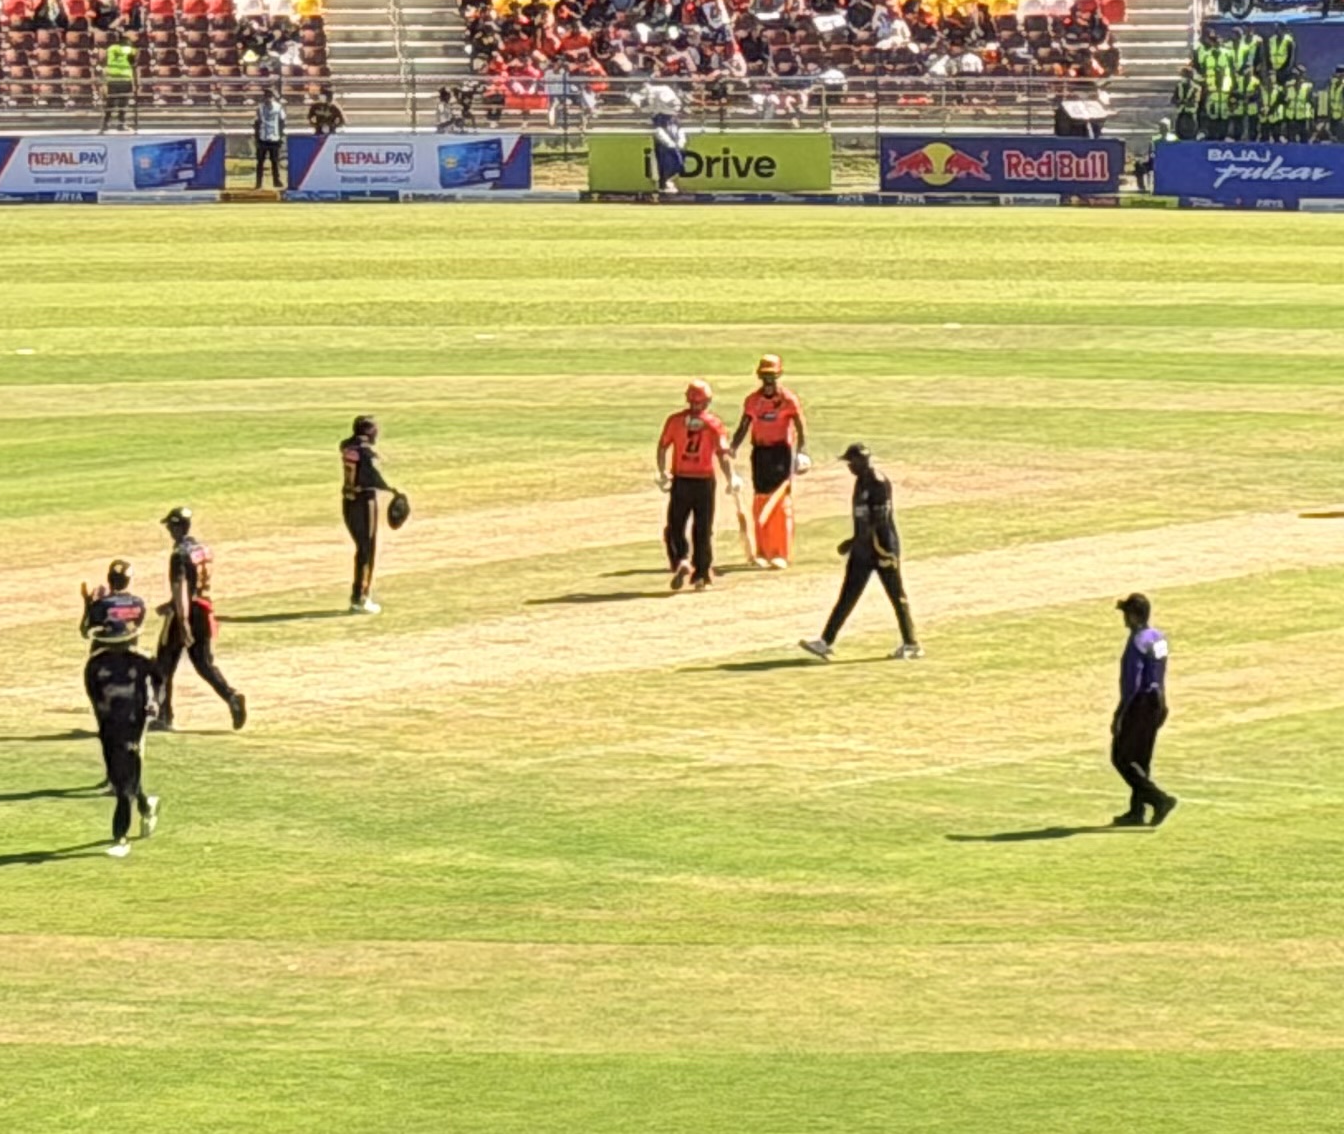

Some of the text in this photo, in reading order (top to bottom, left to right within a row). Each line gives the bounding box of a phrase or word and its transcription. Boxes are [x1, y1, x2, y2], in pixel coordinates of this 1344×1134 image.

[643, 148, 777, 179] iDrive
[1003, 150, 1109, 181] Red Bull
[1207, 148, 1271, 163] BAJAJ
